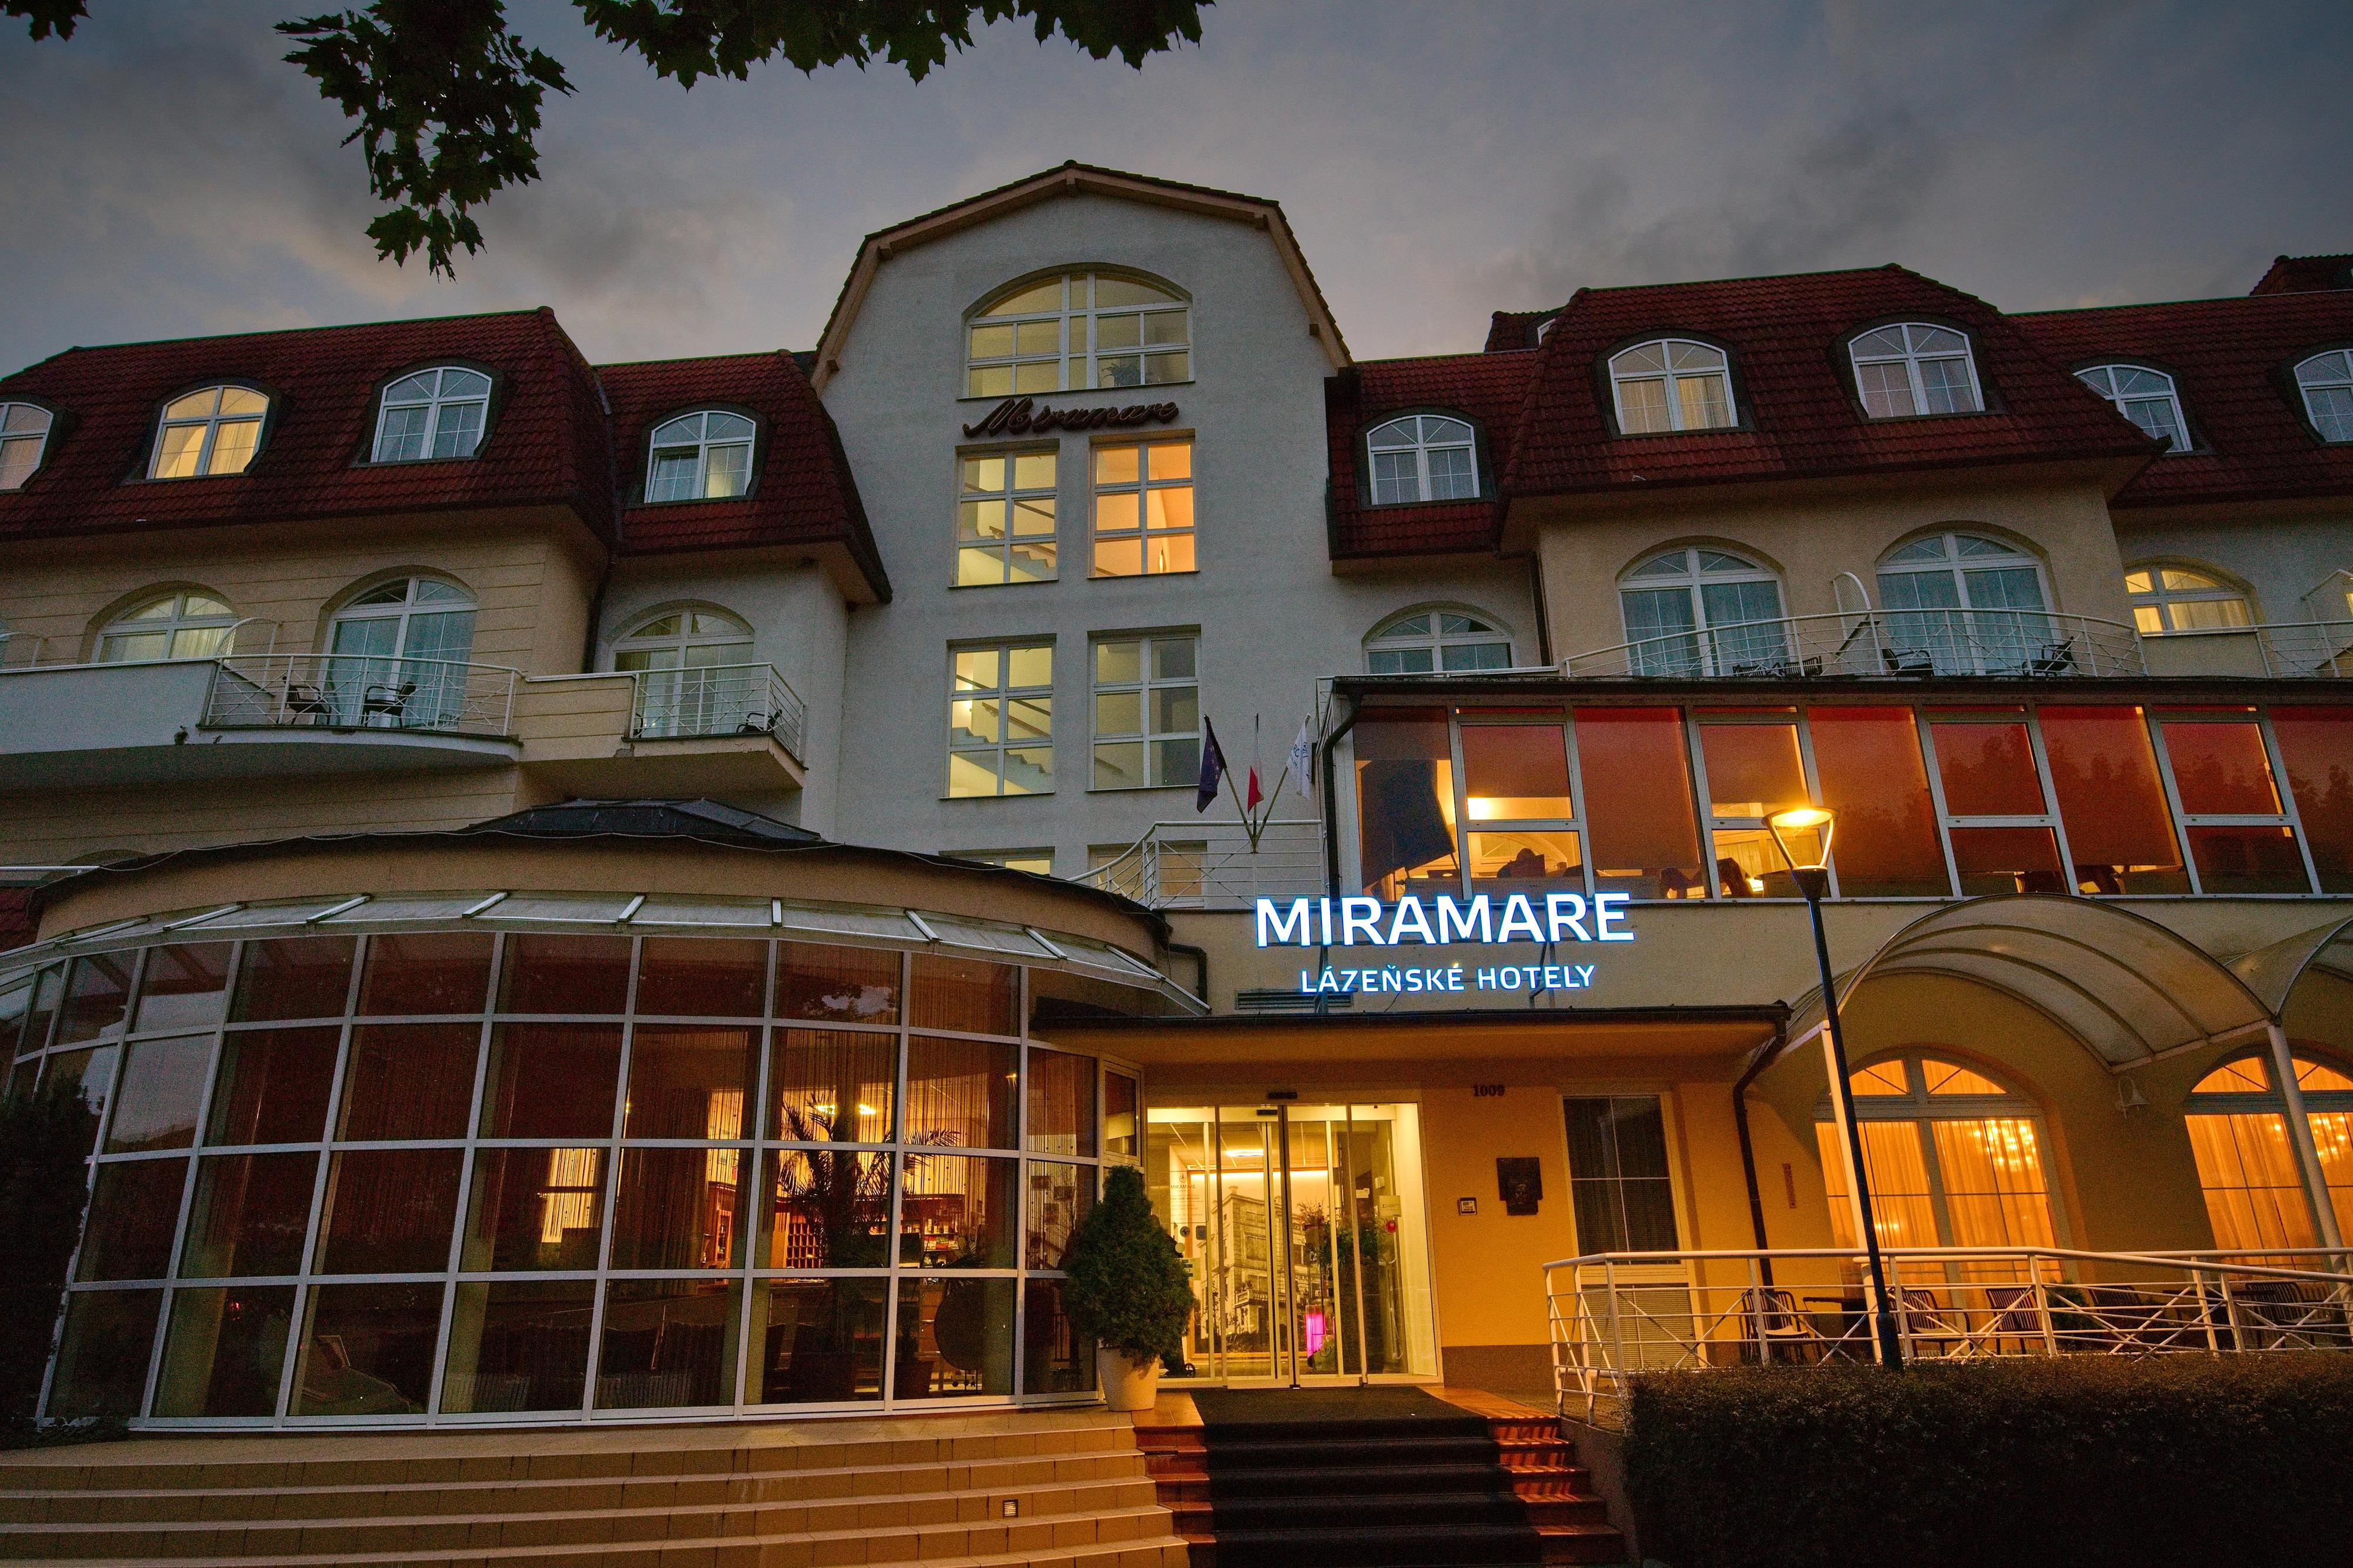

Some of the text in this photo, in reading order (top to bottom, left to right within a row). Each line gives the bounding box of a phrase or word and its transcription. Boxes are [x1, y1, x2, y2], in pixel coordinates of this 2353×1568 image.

[962, 396, 1179, 438] Miramare
[1256, 892, 1635, 946] MIRAMARE
[1301, 963, 1595, 992] LÁZEŇSKÉ HOTELY
[1472, 1083, 1505, 1097] 1009
